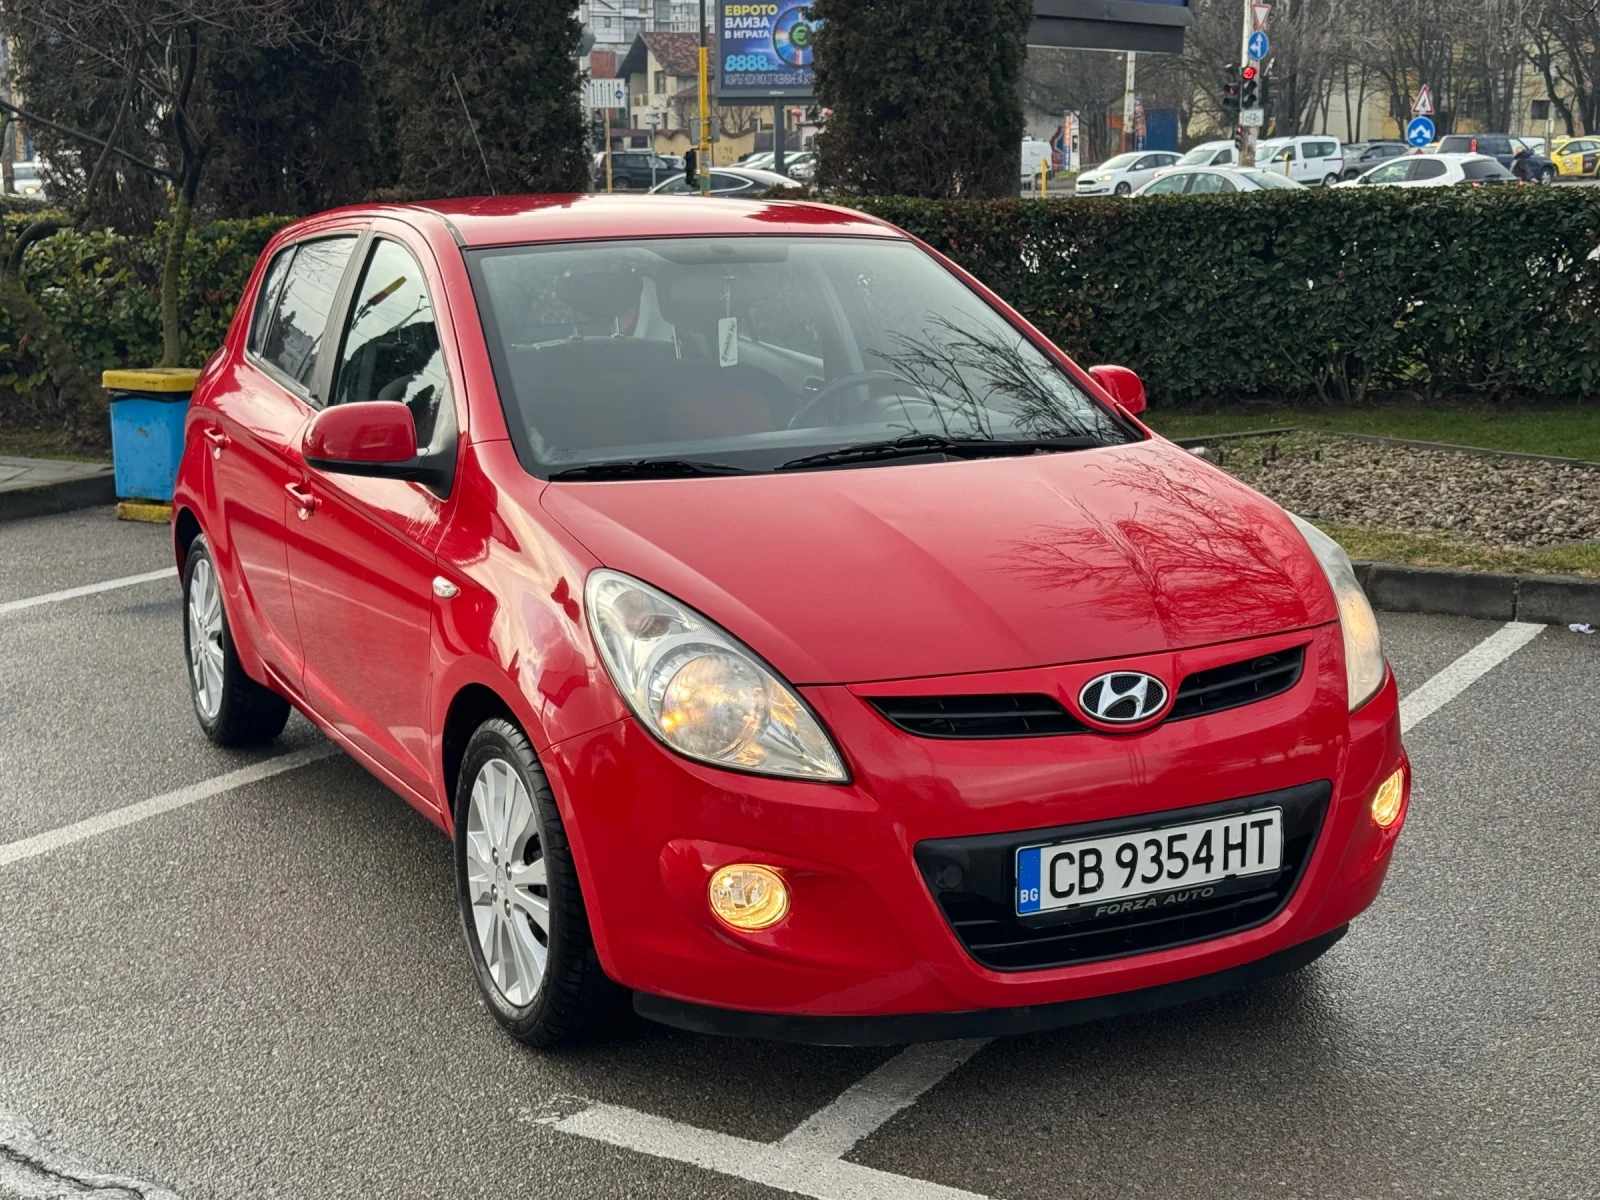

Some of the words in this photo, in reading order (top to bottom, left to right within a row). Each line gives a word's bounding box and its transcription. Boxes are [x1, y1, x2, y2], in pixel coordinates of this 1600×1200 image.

[724, 4, 778, 16] ЕВРОТО
[724, 16, 770, 29] ВЛИЗА
[724, 30, 732, 39] В
[733, 29, 770, 39] ИГРАТА
[1049, 848, 1104, 899] CB
[1115, 828, 1214, 890] 9354
[1222, 818, 1273, 871] HT
[1020, 889, 1039, 904] BG
[1095, 897, 1158, 918] FORZA
[1165, 886, 1215, 905] AUTO
